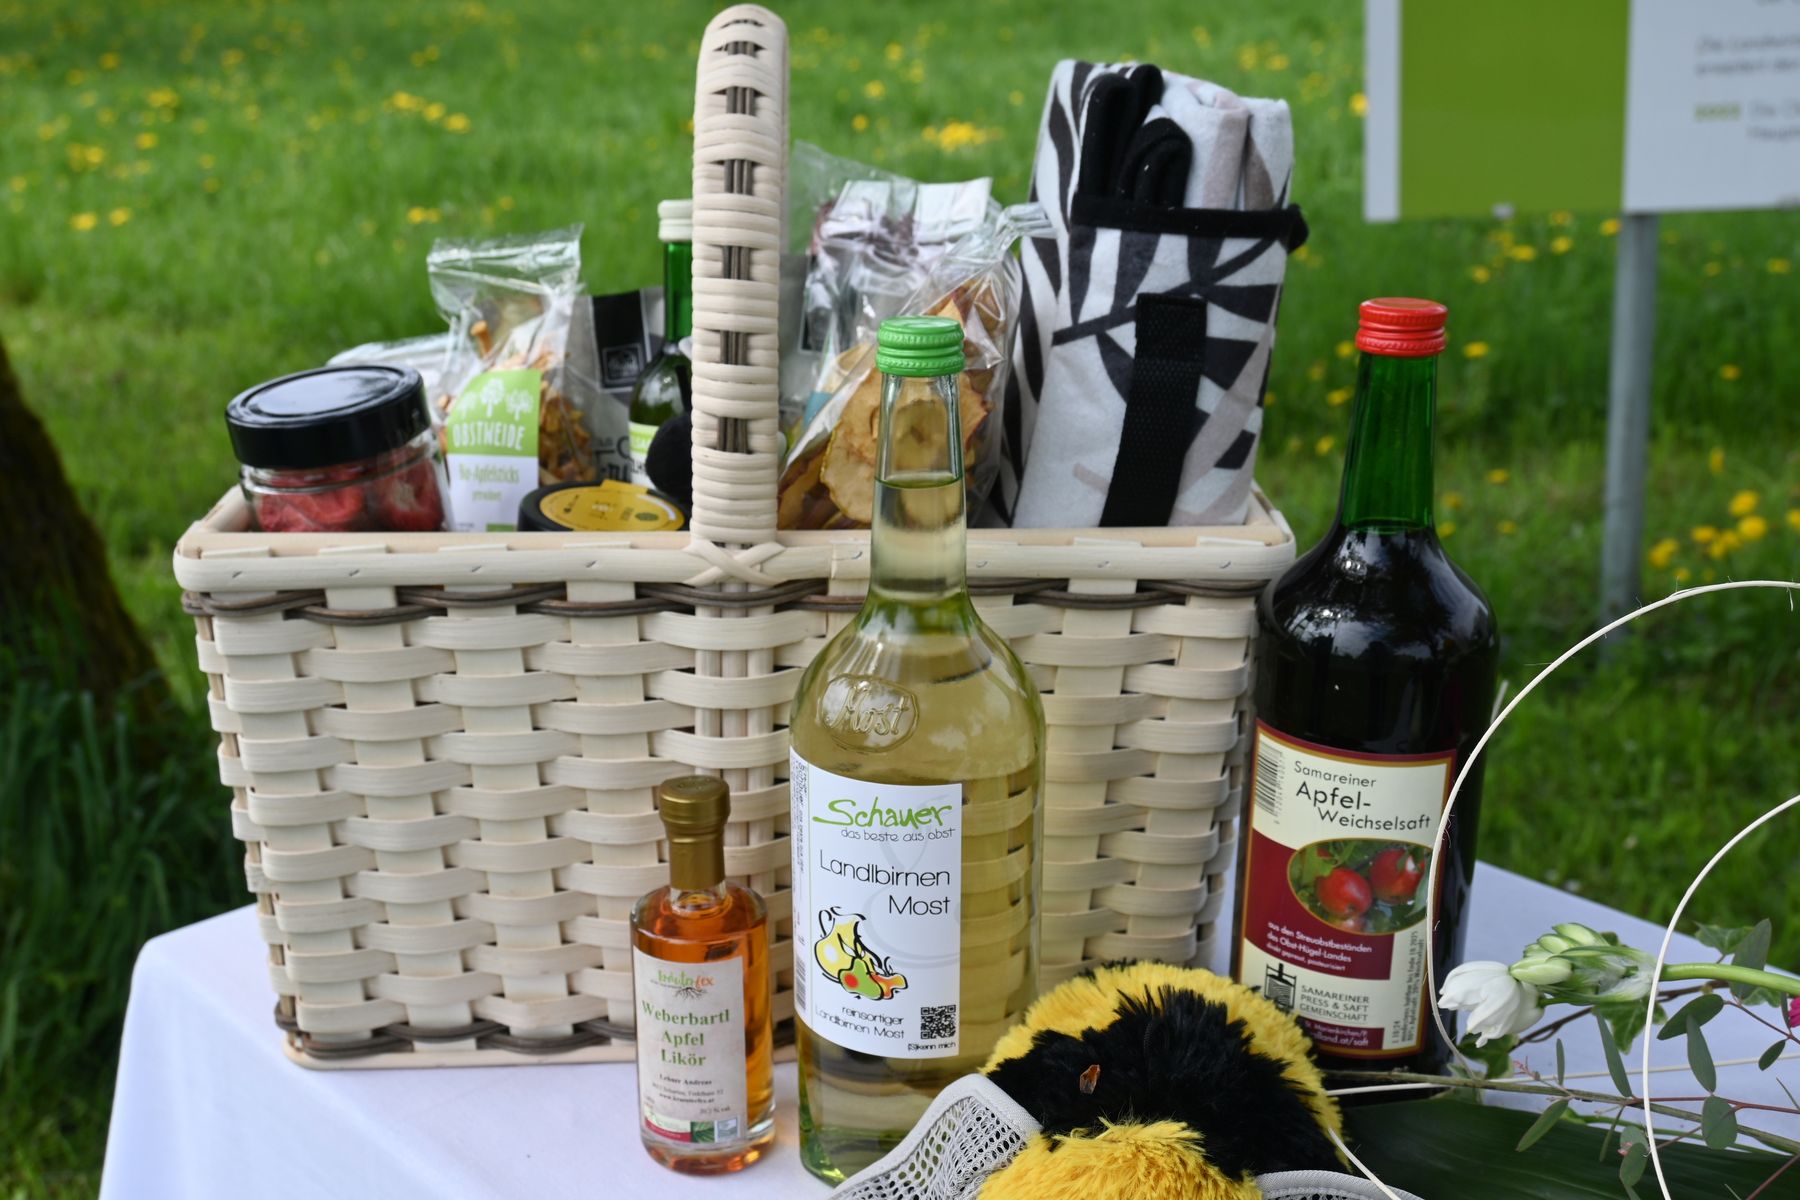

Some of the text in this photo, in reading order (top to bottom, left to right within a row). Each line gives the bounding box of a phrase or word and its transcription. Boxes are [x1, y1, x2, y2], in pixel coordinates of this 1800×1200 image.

[1294, 761, 1376, 788] Samareiner
[1296, 781, 1371, 810] Apfel-
[812, 796, 952, 829] Schauer
[1318, 807, 1431, 831] Weichselsaft
[841, 828, 955, 842] das beste aus obst
[820, 849, 950, 886] Landbirnen
[889, 895, 950, 915] Most
[1296, 931, 1372, 953] Streuobstbeständen
[1300, 994, 1329, 1008] PRESS
[1343, 1003, 1369, 1012] SAFT
[1301, 985, 1370, 1003] SAMAREINER
[642, 1000, 730, 1025] Weberbartl
[815, 1004, 904, 1039] Landbirnen Most
[842, 1006, 904, 1025] reinsortiger
[1299, 1003, 1368, 1021] GEMEINSCHAFT
[662, 1030, 704, 1047] Apfel
[661, 1049, 706, 1066] Likör
